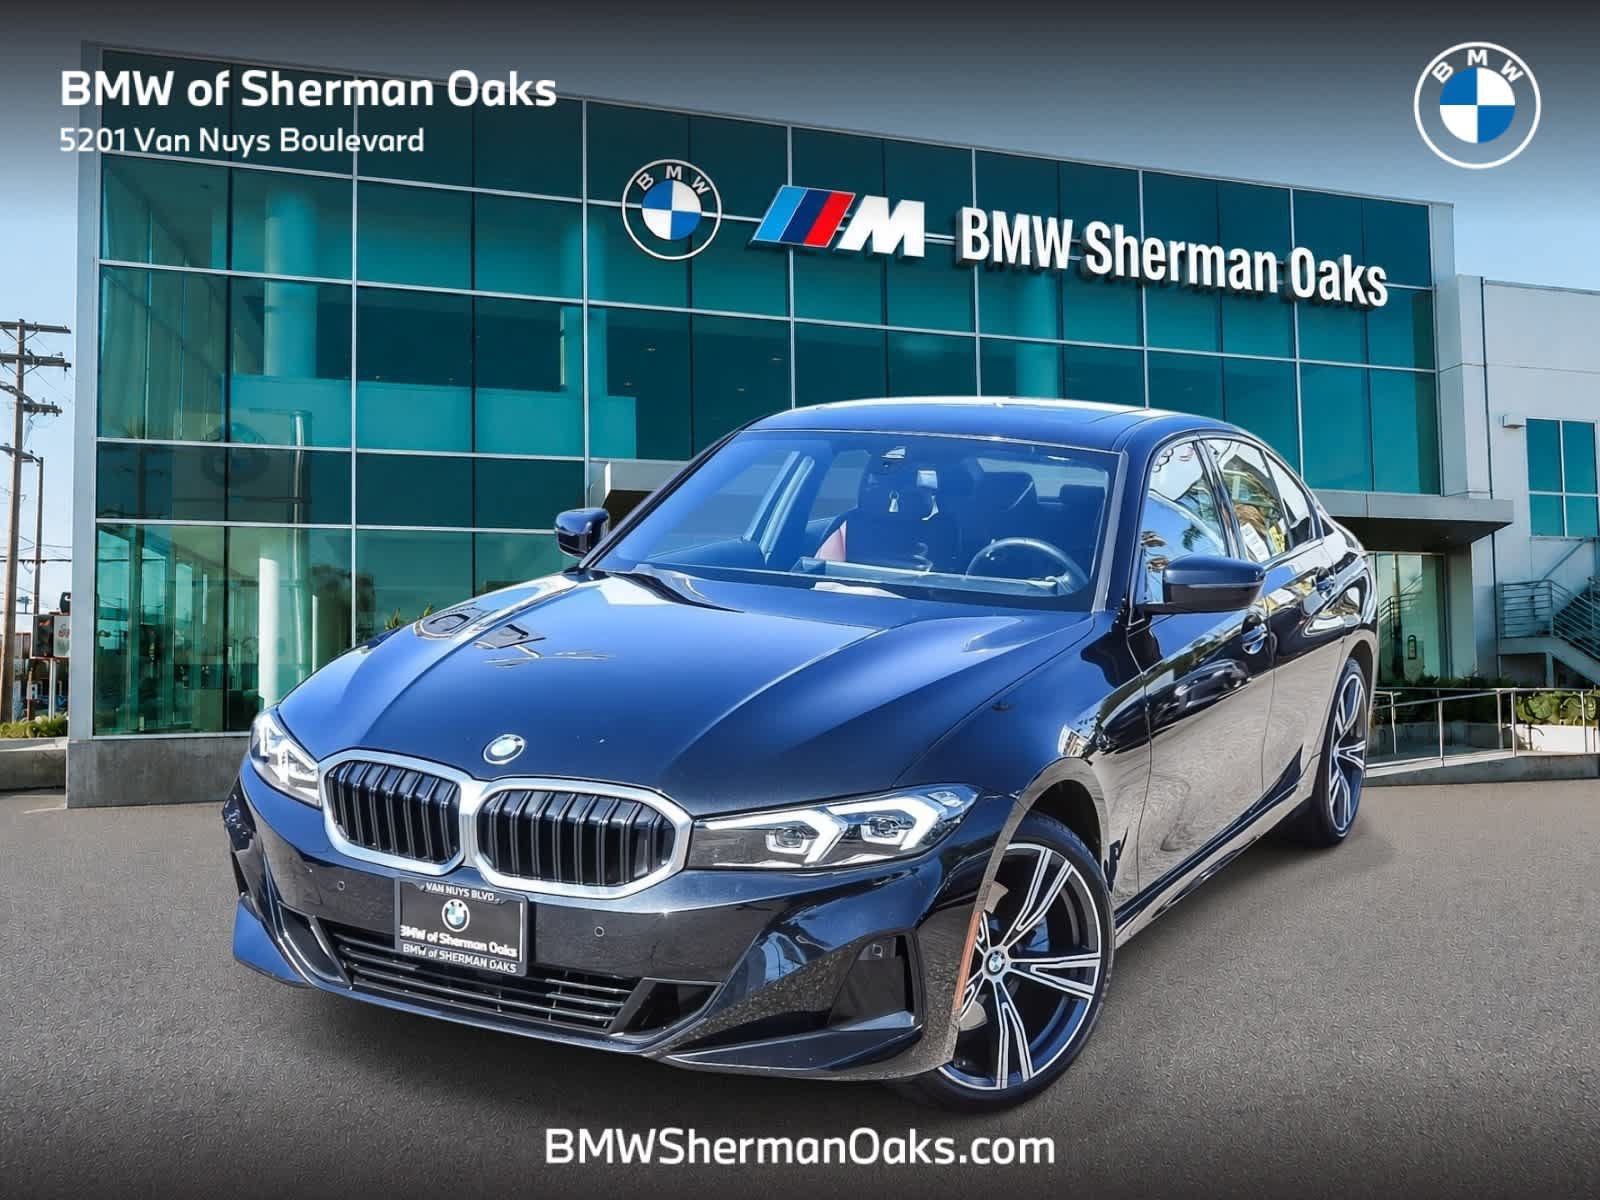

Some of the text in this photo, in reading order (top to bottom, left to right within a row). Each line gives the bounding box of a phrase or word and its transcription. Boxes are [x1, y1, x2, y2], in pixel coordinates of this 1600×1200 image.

[636, 165, 710, 194] BMW
[960, 207, 1388, 308] BMW Sherman Oaks
[425, 882, 494, 901] VAN NUYS BLVD
[403, 943, 517, 973] BMW of SHERMAN OAKS
[427, 932, 439, 942] of
[439, 933, 487, 952] Sherman
[489, 942, 518, 958] Oaks
